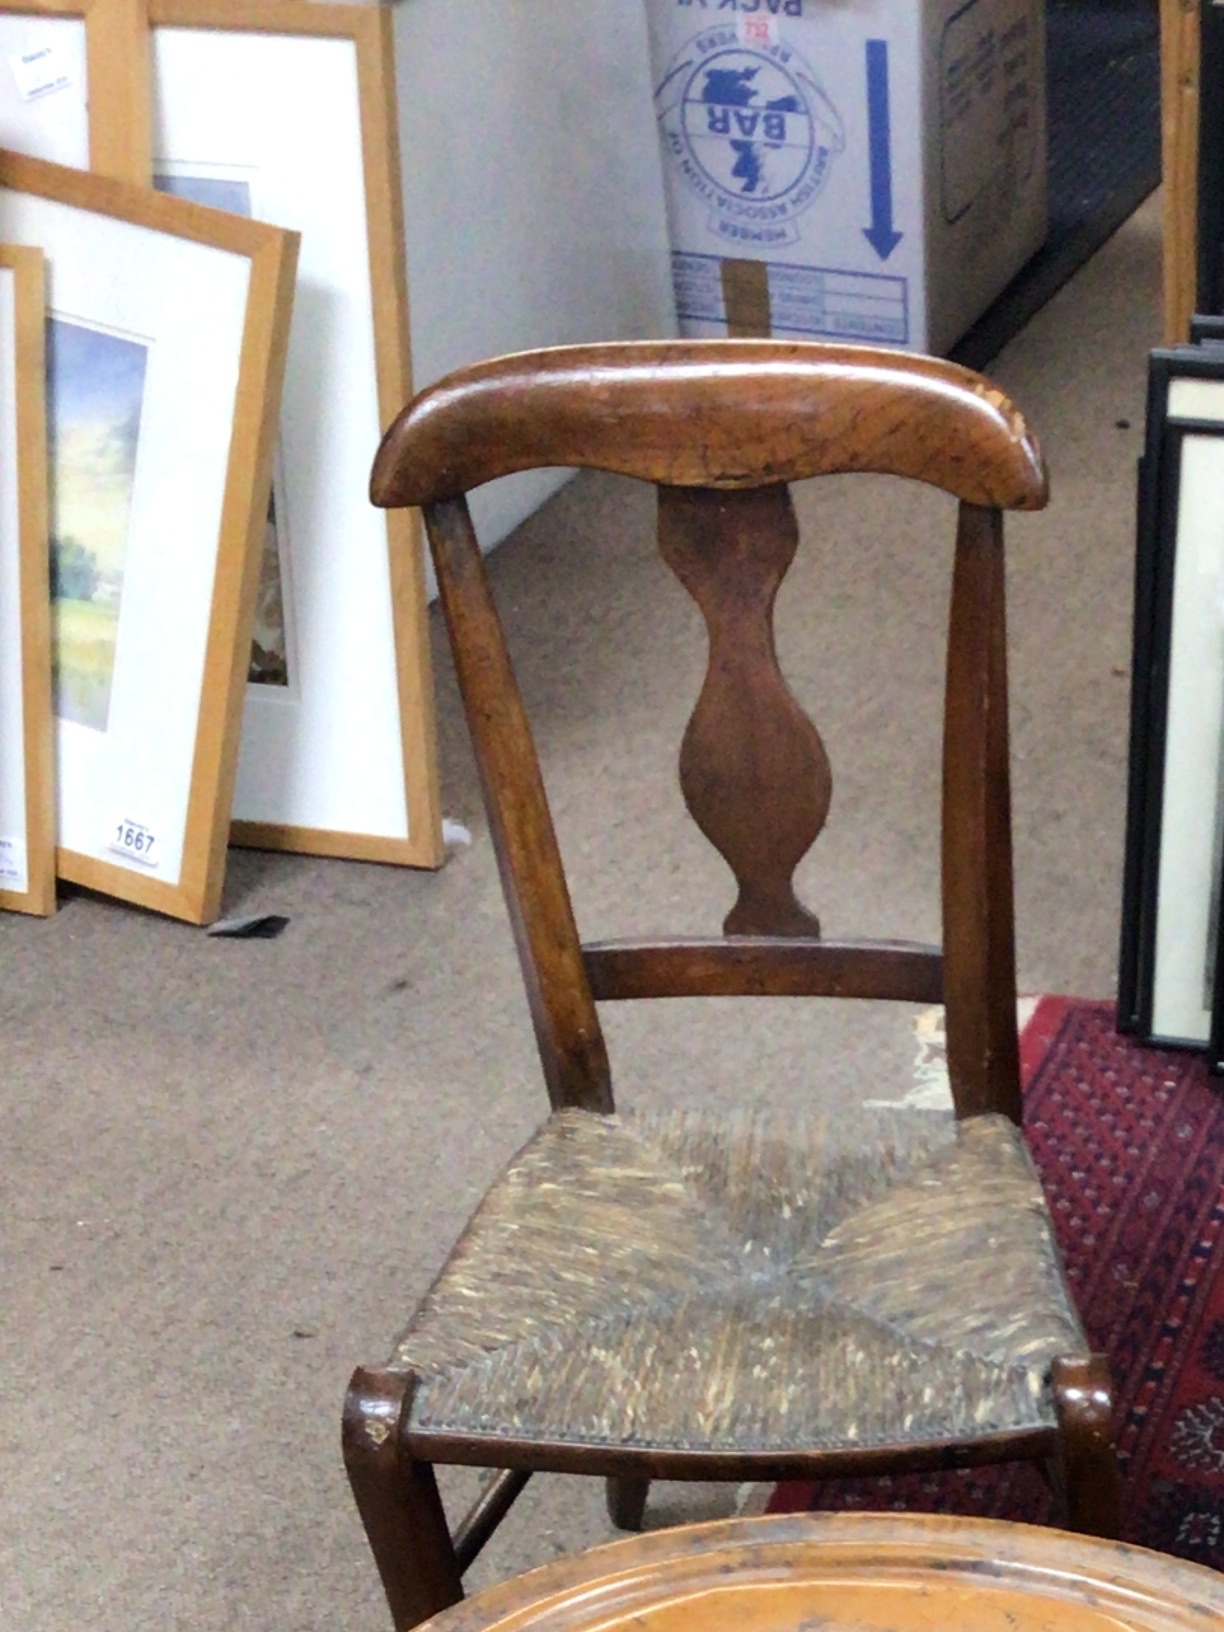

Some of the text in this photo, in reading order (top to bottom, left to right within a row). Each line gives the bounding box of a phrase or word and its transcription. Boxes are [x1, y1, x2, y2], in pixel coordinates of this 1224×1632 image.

[708, 105, 786, 140] BAR
[681, 159, 788, 219] ASSOCIATION
[791, 145, 829, 206] BRITISH
[718, 219, 788, 242] MEMBER
[116, 824, 155, 854] 1667
